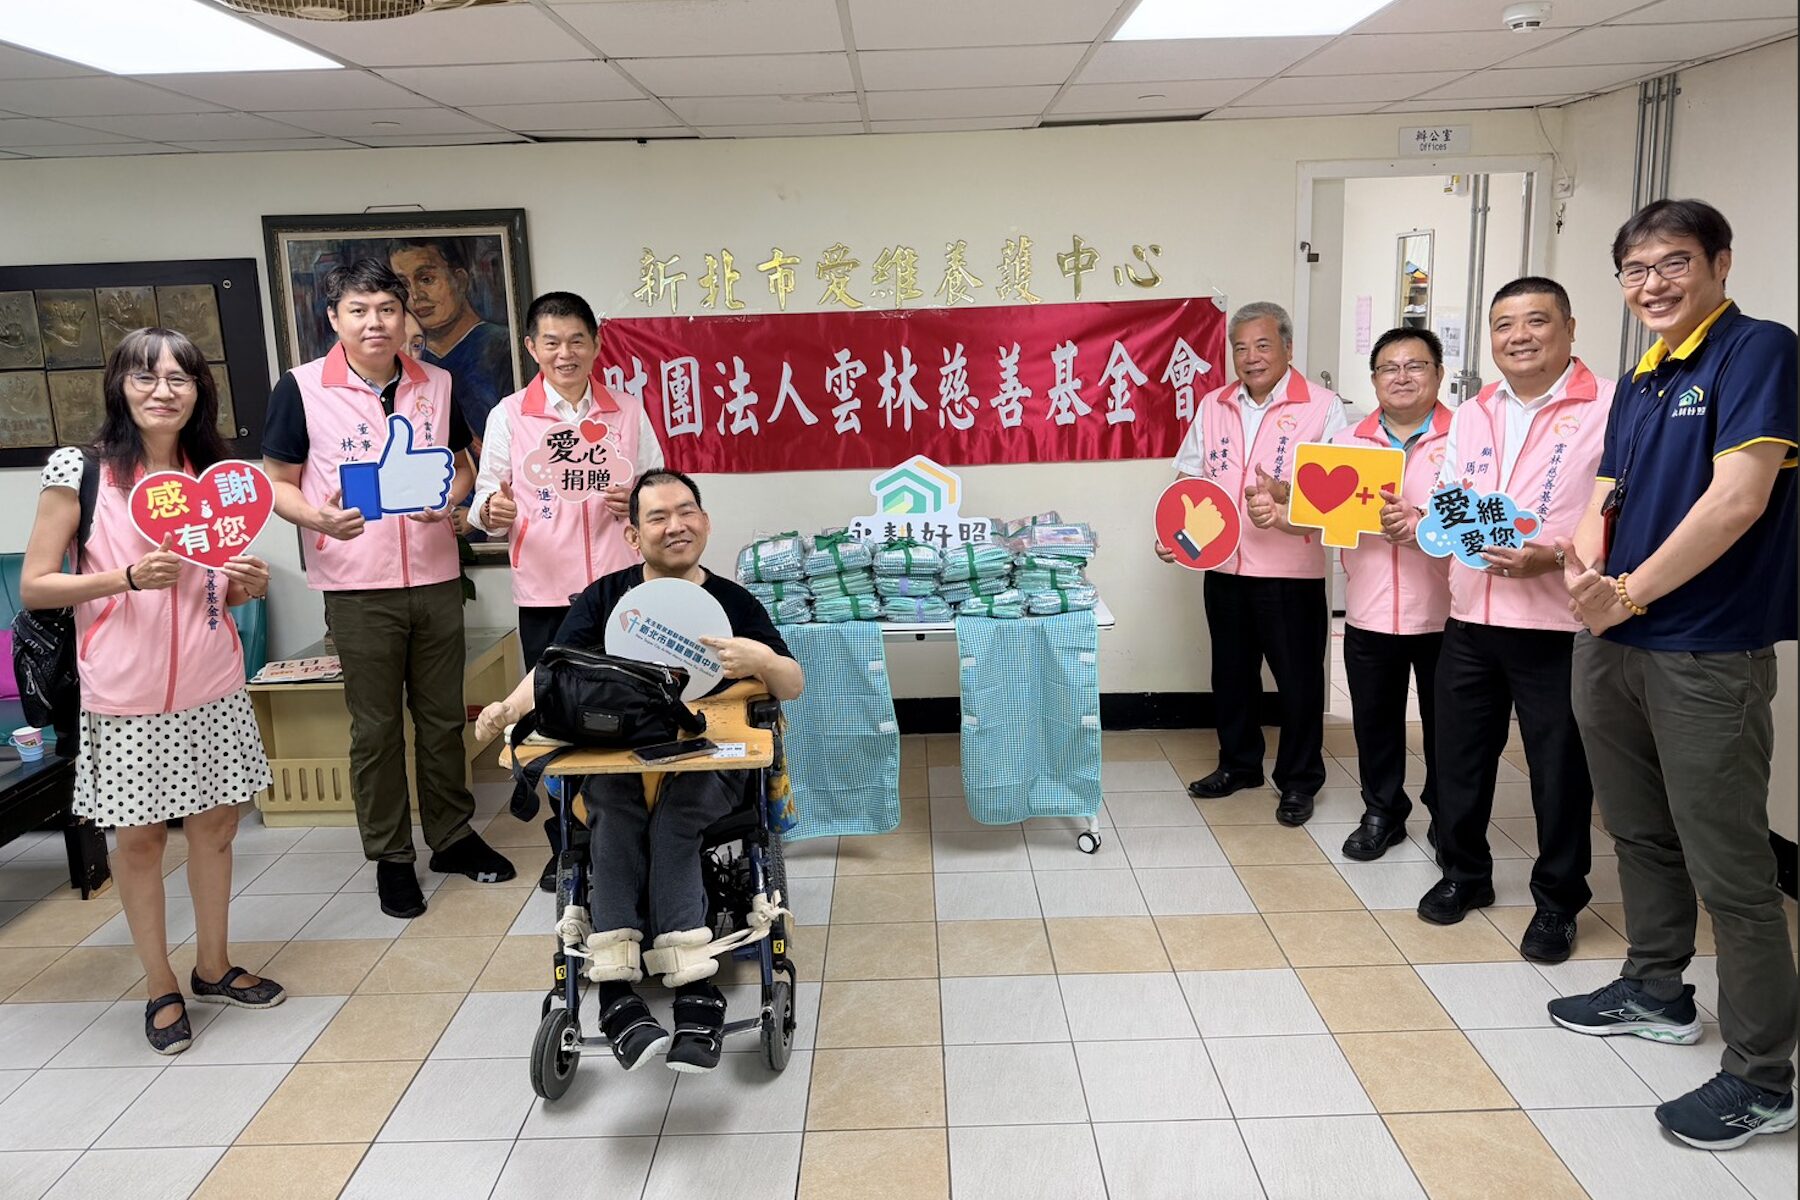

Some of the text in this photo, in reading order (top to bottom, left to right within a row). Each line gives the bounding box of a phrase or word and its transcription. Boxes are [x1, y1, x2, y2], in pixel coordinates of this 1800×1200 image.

[1415, 128, 1453, 142] 辦公室
[1419, 142, 1447, 151] Offices
[633, 235, 1163, 314] 新北市愛維養護中心
[341, 438, 358, 461] 林
[424, 421, 433, 447] 雲林
[547, 429, 607, 465] 愛心
[146, 467, 258, 520] 感謝
[561, 468, 611, 491] 捐贈
[1434, 487, 1508, 530] 愛維
[174, 515, 251, 556] 有您
[1461, 526, 1518, 557] 愛您
